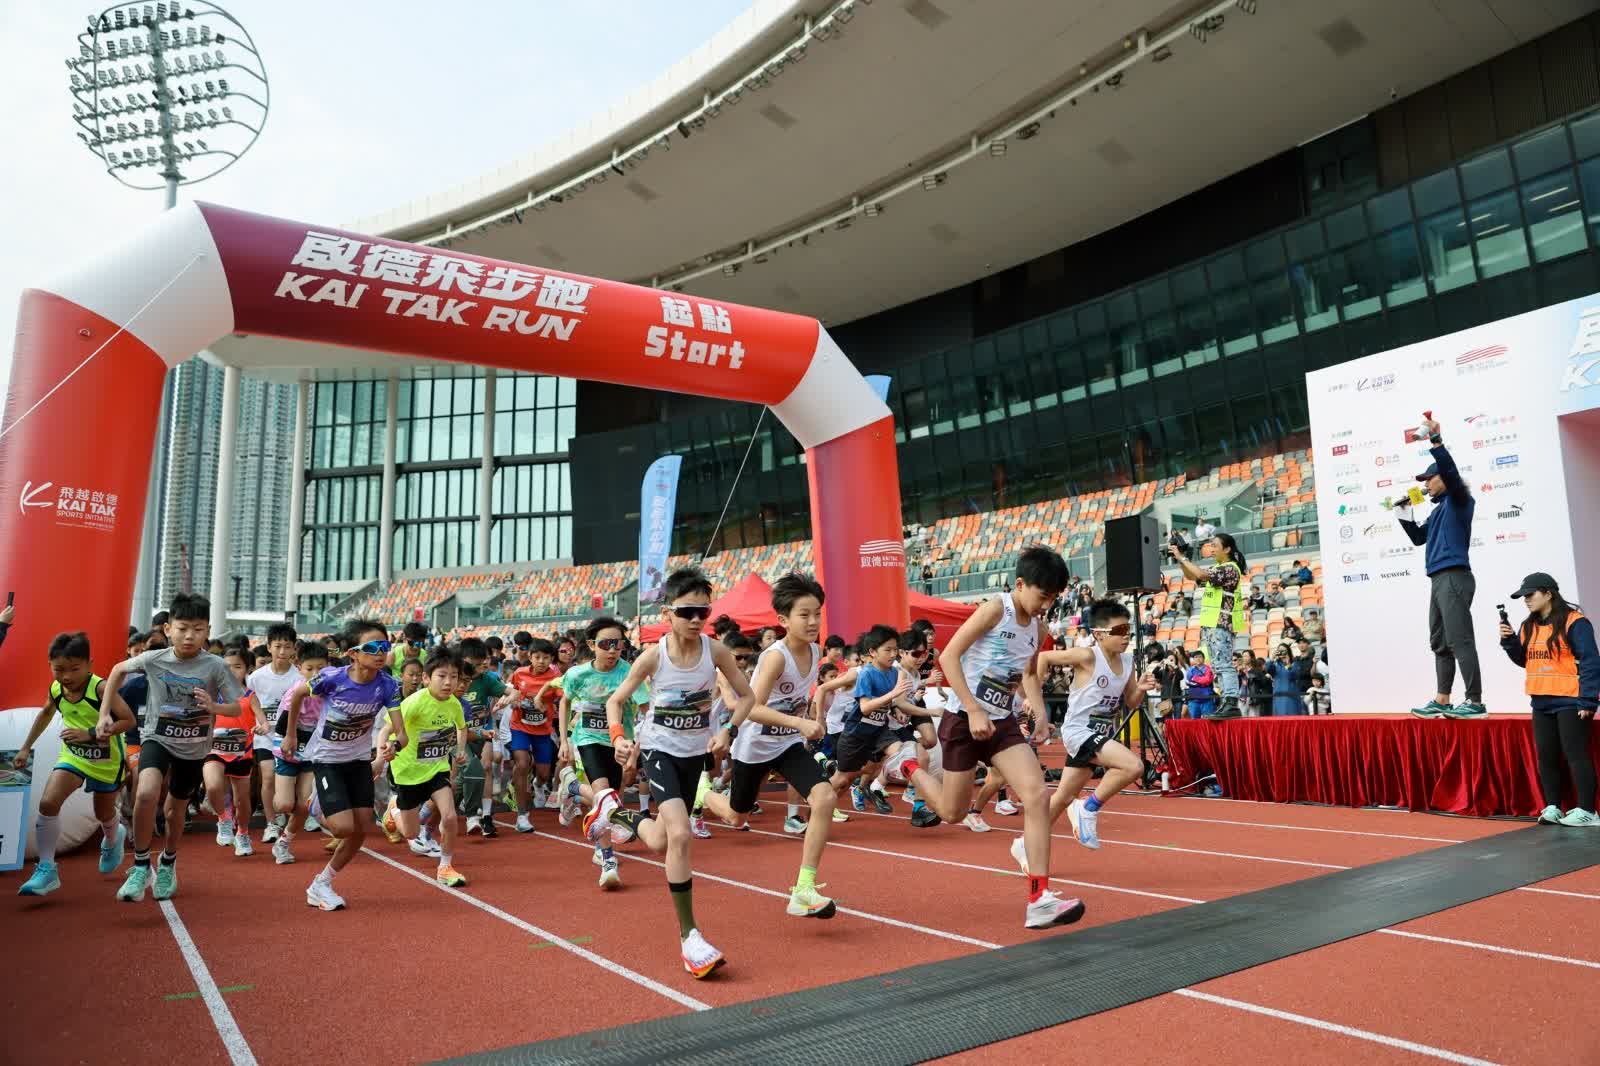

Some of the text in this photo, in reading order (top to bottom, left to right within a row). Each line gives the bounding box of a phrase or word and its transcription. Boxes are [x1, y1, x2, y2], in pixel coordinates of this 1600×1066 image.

[274, 271, 581, 341] KAI TAK RUN
[660, 296, 732, 334] 起點
[645, 325, 745, 369] Start
[59, 487, 118, 506] 飛越啟德
[57, 499, 116, 516] KAI TAK
[56, 510, 83, 519] SPORTS
[1498, 510, 1520, 519] PUMA
[1343, 573, 1369, 583] TATA
[590, 719, 609, 728] 507
[664, 715, 701, 728] 5082
[165, 725, 200, 737] 5066
[71, 746, 101, 758] 5040
[213, 742, 240, 751] 5515
